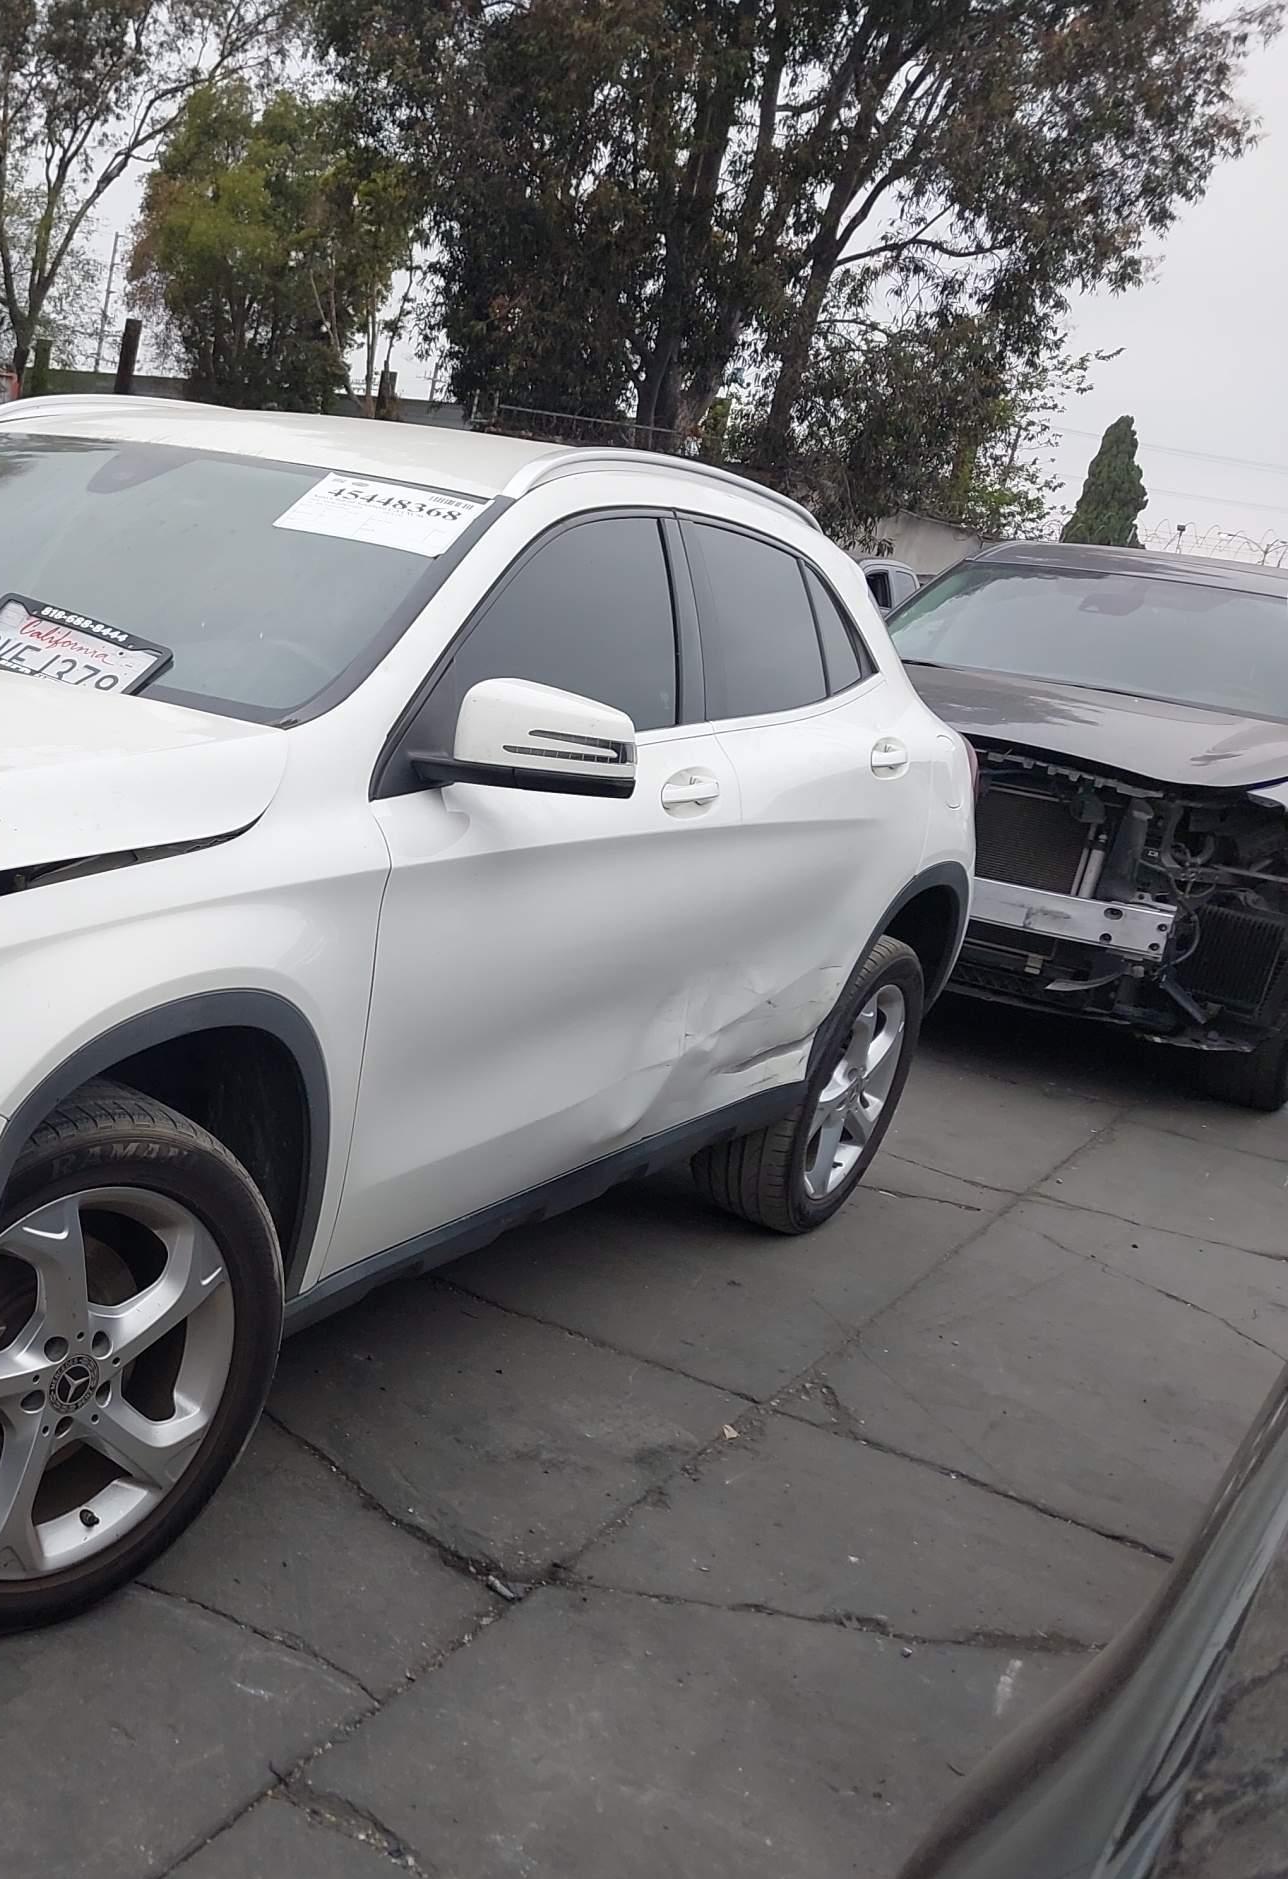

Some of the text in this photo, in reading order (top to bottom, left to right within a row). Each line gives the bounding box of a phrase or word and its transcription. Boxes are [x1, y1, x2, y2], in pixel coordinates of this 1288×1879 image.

[327, 488, 462, 521] 45448368
[19, 619, 114, 666] California
[40, 606, 130, 643] 818-688-8444
